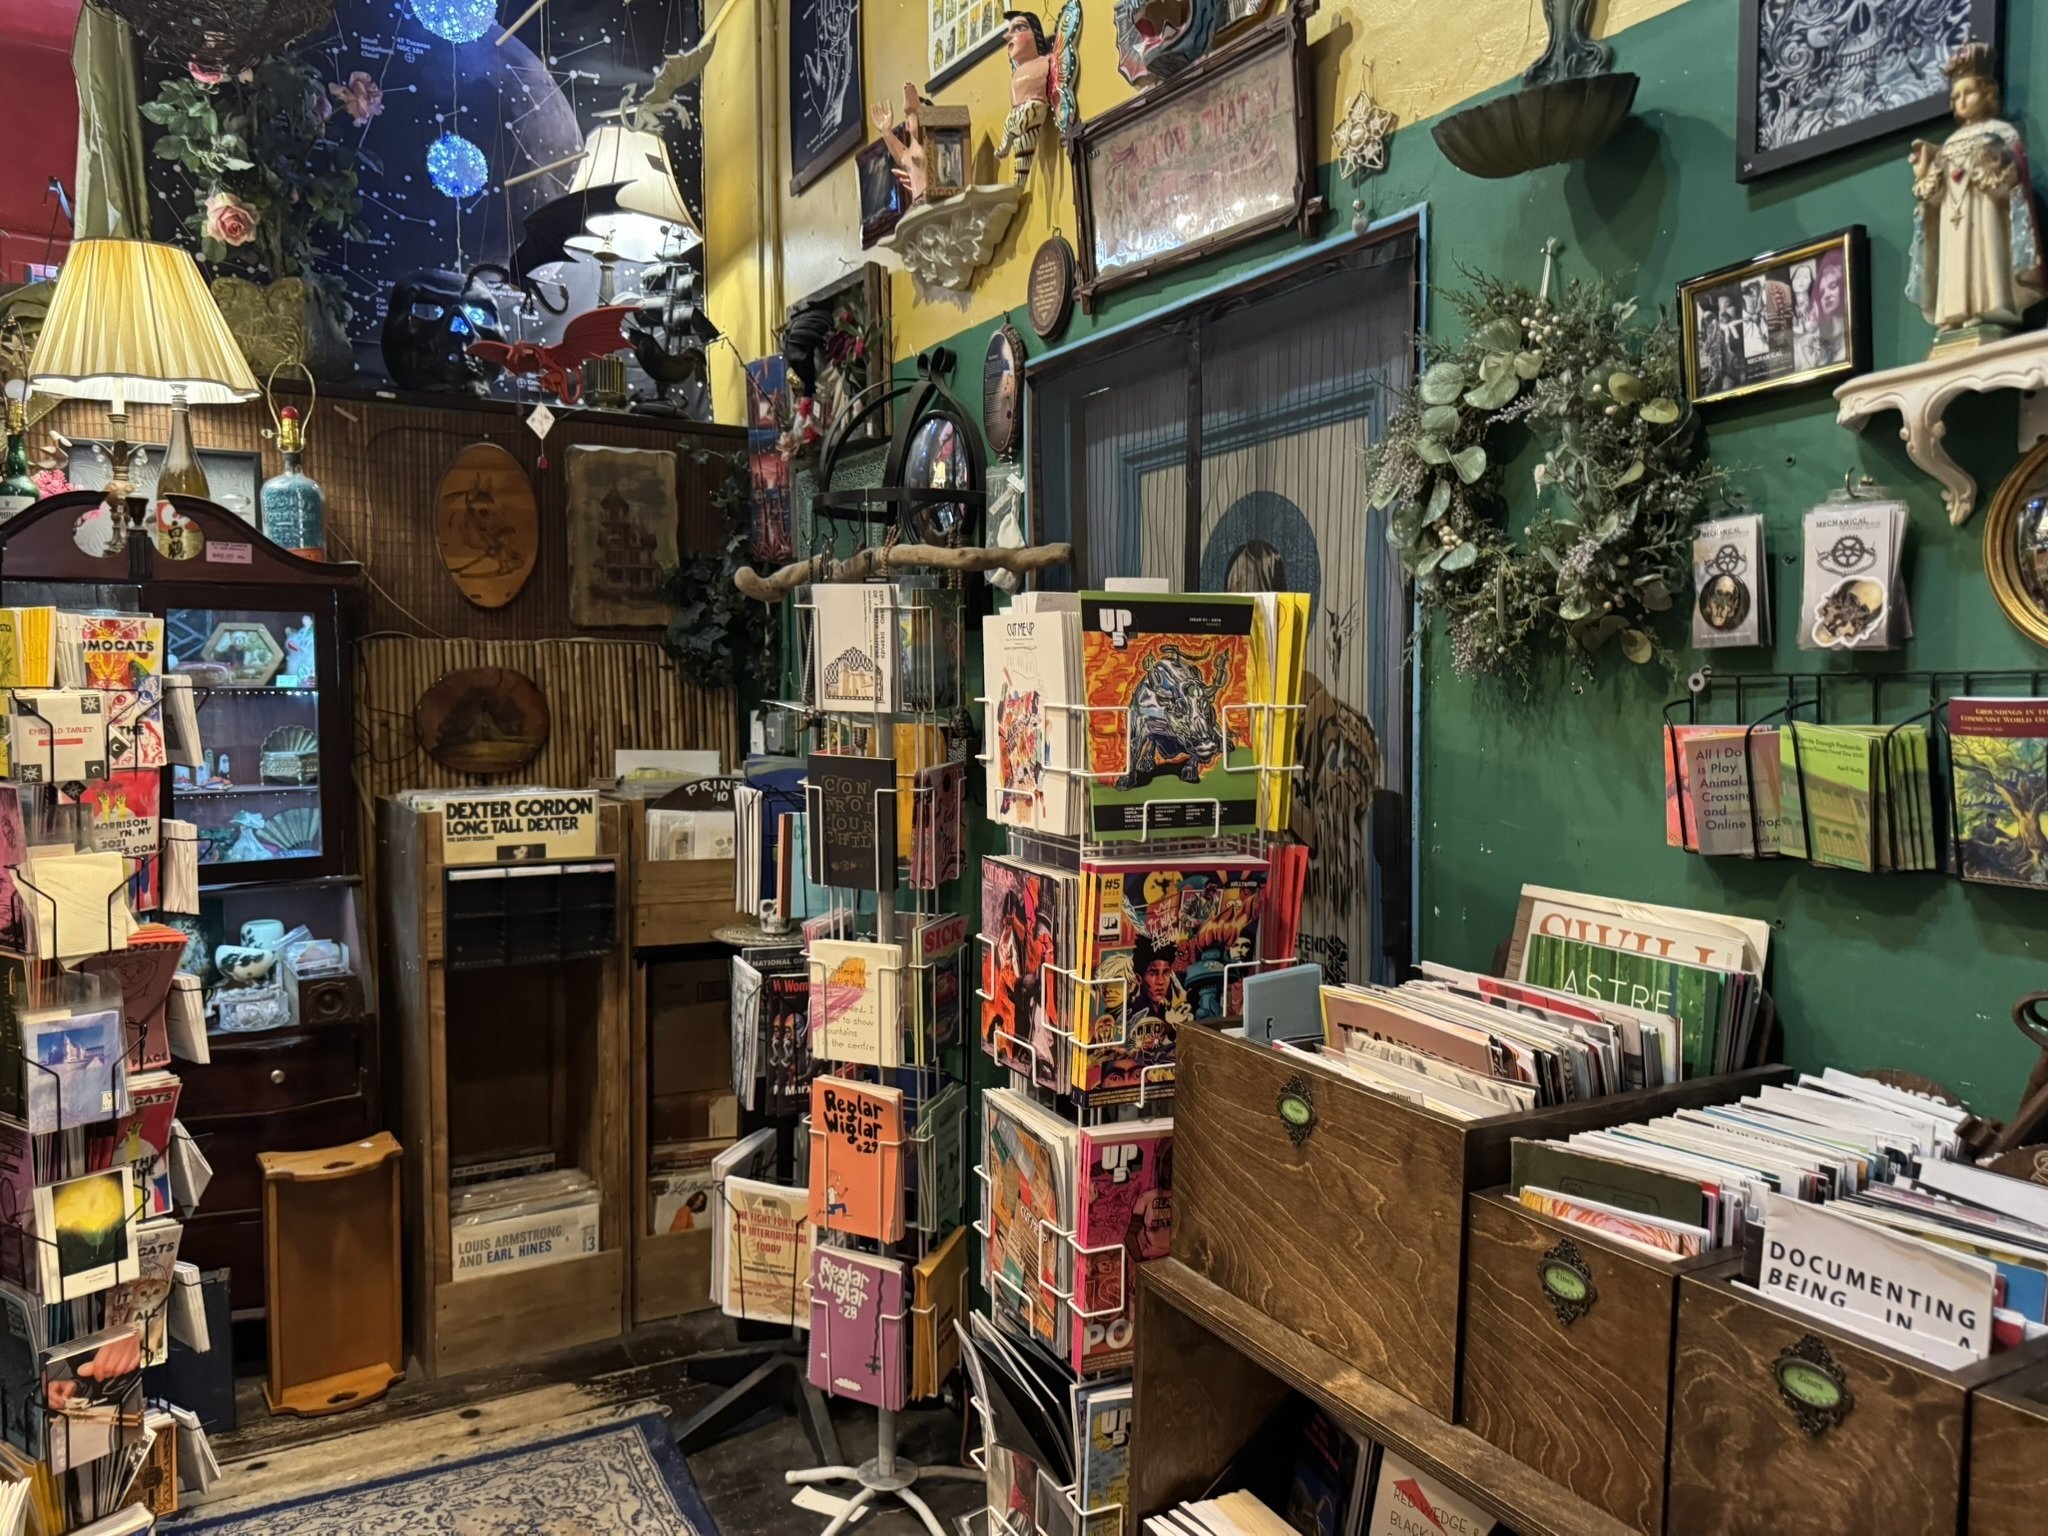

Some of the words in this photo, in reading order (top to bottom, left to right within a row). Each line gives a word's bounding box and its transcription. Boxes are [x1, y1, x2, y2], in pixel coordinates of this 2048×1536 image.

[1816, 518, 1867, 528] MECHANICAL
[1099, 608, 1132, 632] UP
[1007, 623, 1017, 636] CUT
[1017, 622, 1026, 636] ME
[83, 640, 154, 652] MOCATS
[1112, 631, 1125, 647] 5
[119, 726, 144, 735] THE
[1696, 748, 1711, 761] All
[1716, 748, 1720, 758] I
[1725, 747, 1742, 758] Do
[1698, 766, 1706, 774] is
[1711, 764, 1737, 776] Play
[1700, 775, 1742, 789] Animal
[446, 801, 512, 820] DEXTER
[515, 797, 593, 817] GORDON
[1704, 805, 1727, 816] and
[446, 820, 489, 836] LONG
[491, 818, 524, 834] TALL
[527, 816, 579, 832] DEXTER
[1706, 818, 1747, 831] Online
[1105, 879, 1120, 889] #5
[1102, 917, 1118, 929] UP
[924, 920, 962, 954] SICK
[752, 958, 791, 967] NATIONAL
[784, 981, 808, 993] Wom
[853, 1018, 873, 1027] show
[827, 1028, 857, 1038] ountains
[832, 1041, 844, 1049] the
[848, 1042, 875, 1050] centre
[132, 1052, 169, 1067] PACE
[134, 1092, 173, 1106] CATS
[824, 1089, 883, 1122] Reglar
[824, 1111, 883, 1145] Wiglar
[856, 1141, 879, 1153] #29
[1102, 1144, 1138, 1170] UP
[1113, 1167, 1128, 1183] 5
[751, 1213, 770, 1224] FIGHT
[774, 1216, 788, 1226] FOR
[458, 1238, 491, 1255] LOUIS
[495, 1224, 562, 1248] ARMSTRONG
[138, 1242, 175, 1257] CATS
[459, 1252, 483, 1269] AND
[486, 1248, 514, 1265] EARL
[518, 1240, 552, 1258] HINES
[756, 1242, 781, 1254] TODAY
[820, 1257, 870, 1290] Reglar
[818, 1272, 869, 1309] Wiglar
[1768, 1268, 1847, 1308] BEING
[1770, 1240, 1976, 1331] DOCUMENTING
[838, 1305, 858, 1320] #28
[1886, 1308, 1912, 1330] IN
[1394, 1487, 1415, 1509] RED
[1420, 1503, 1469, 1534] WEDGE
